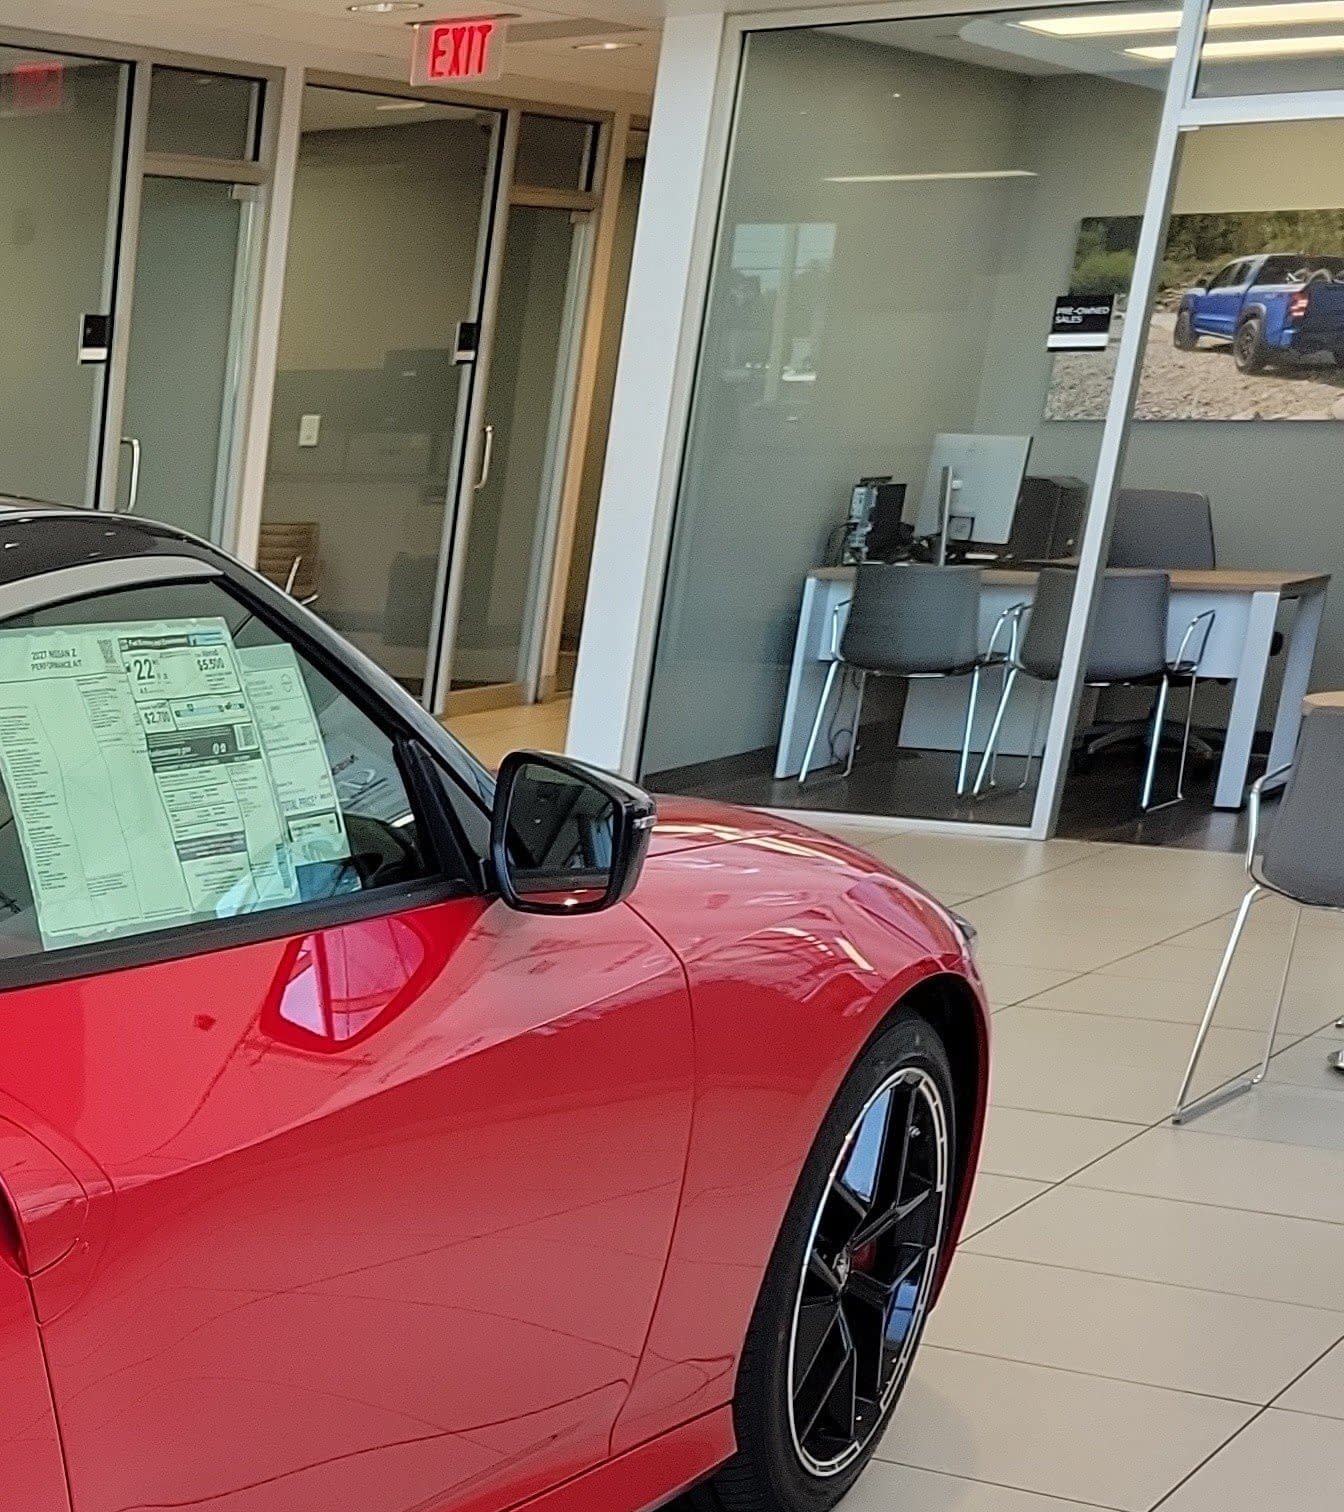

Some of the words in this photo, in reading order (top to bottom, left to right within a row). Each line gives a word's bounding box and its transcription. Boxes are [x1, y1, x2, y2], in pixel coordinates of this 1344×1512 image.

[430, 24, 493, 78] EXIT
[1056, 306, 1110, 315] PRE-OWNED
[1054, 315, 1083, 324] SALES
[133, 659, 156, 681] 22
